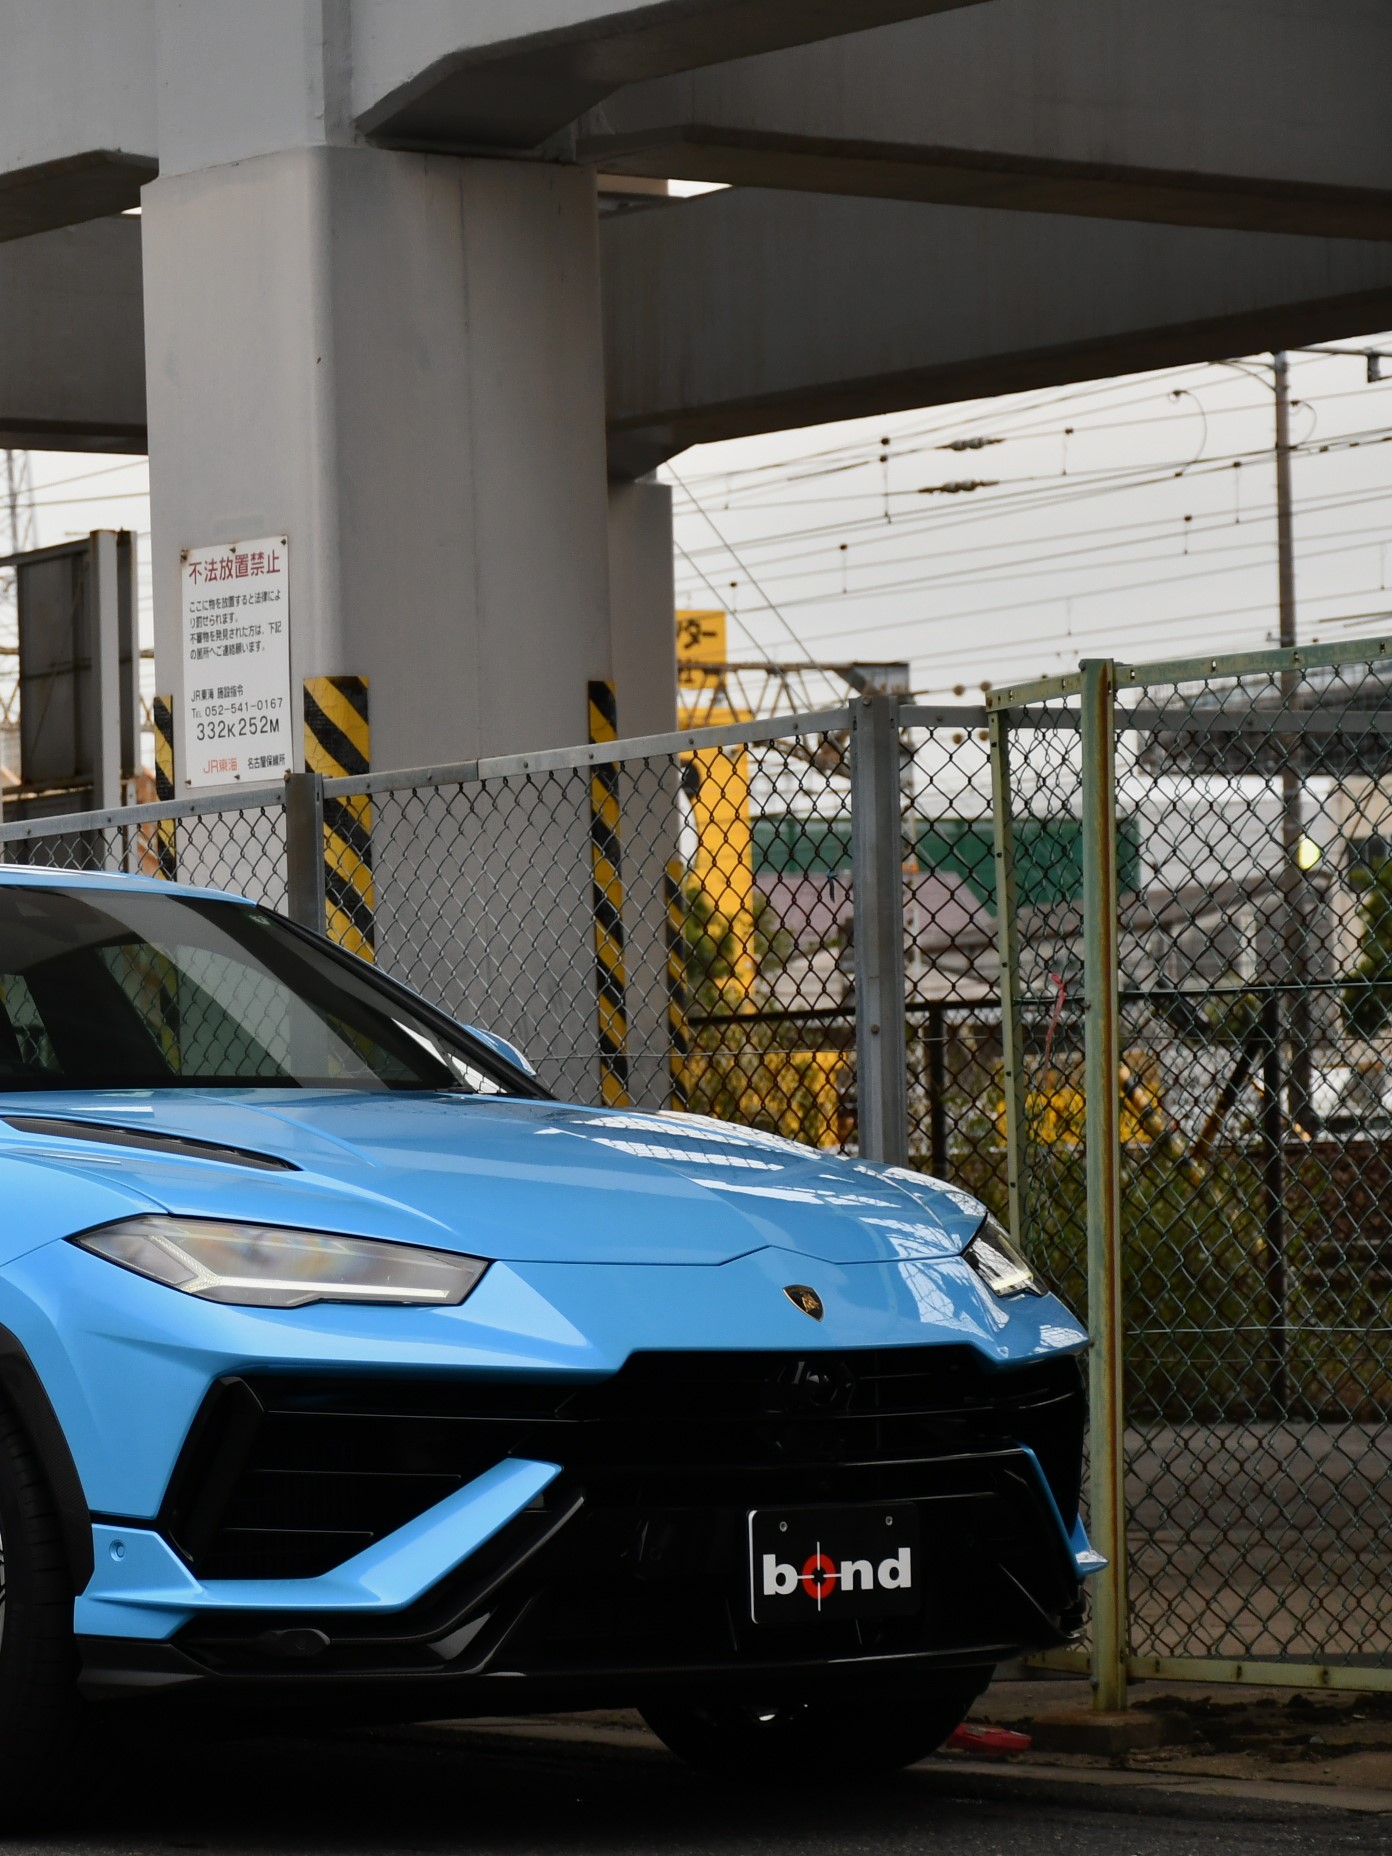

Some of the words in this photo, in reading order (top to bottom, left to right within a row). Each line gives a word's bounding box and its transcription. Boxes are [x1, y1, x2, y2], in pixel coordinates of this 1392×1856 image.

[189, 549, 281, 585] 不法放置禁止
[189, 589, 281, 613] ここに物を放置すると法律によ
[191, 689, 214, 702] JR東海
[205, 697, 283, 717] 052-541-0167
[197, 715, 280, 741] 332K252M
[203, 758, 238, 774] JR東海
[763, 1546, 912, 1600] bond
